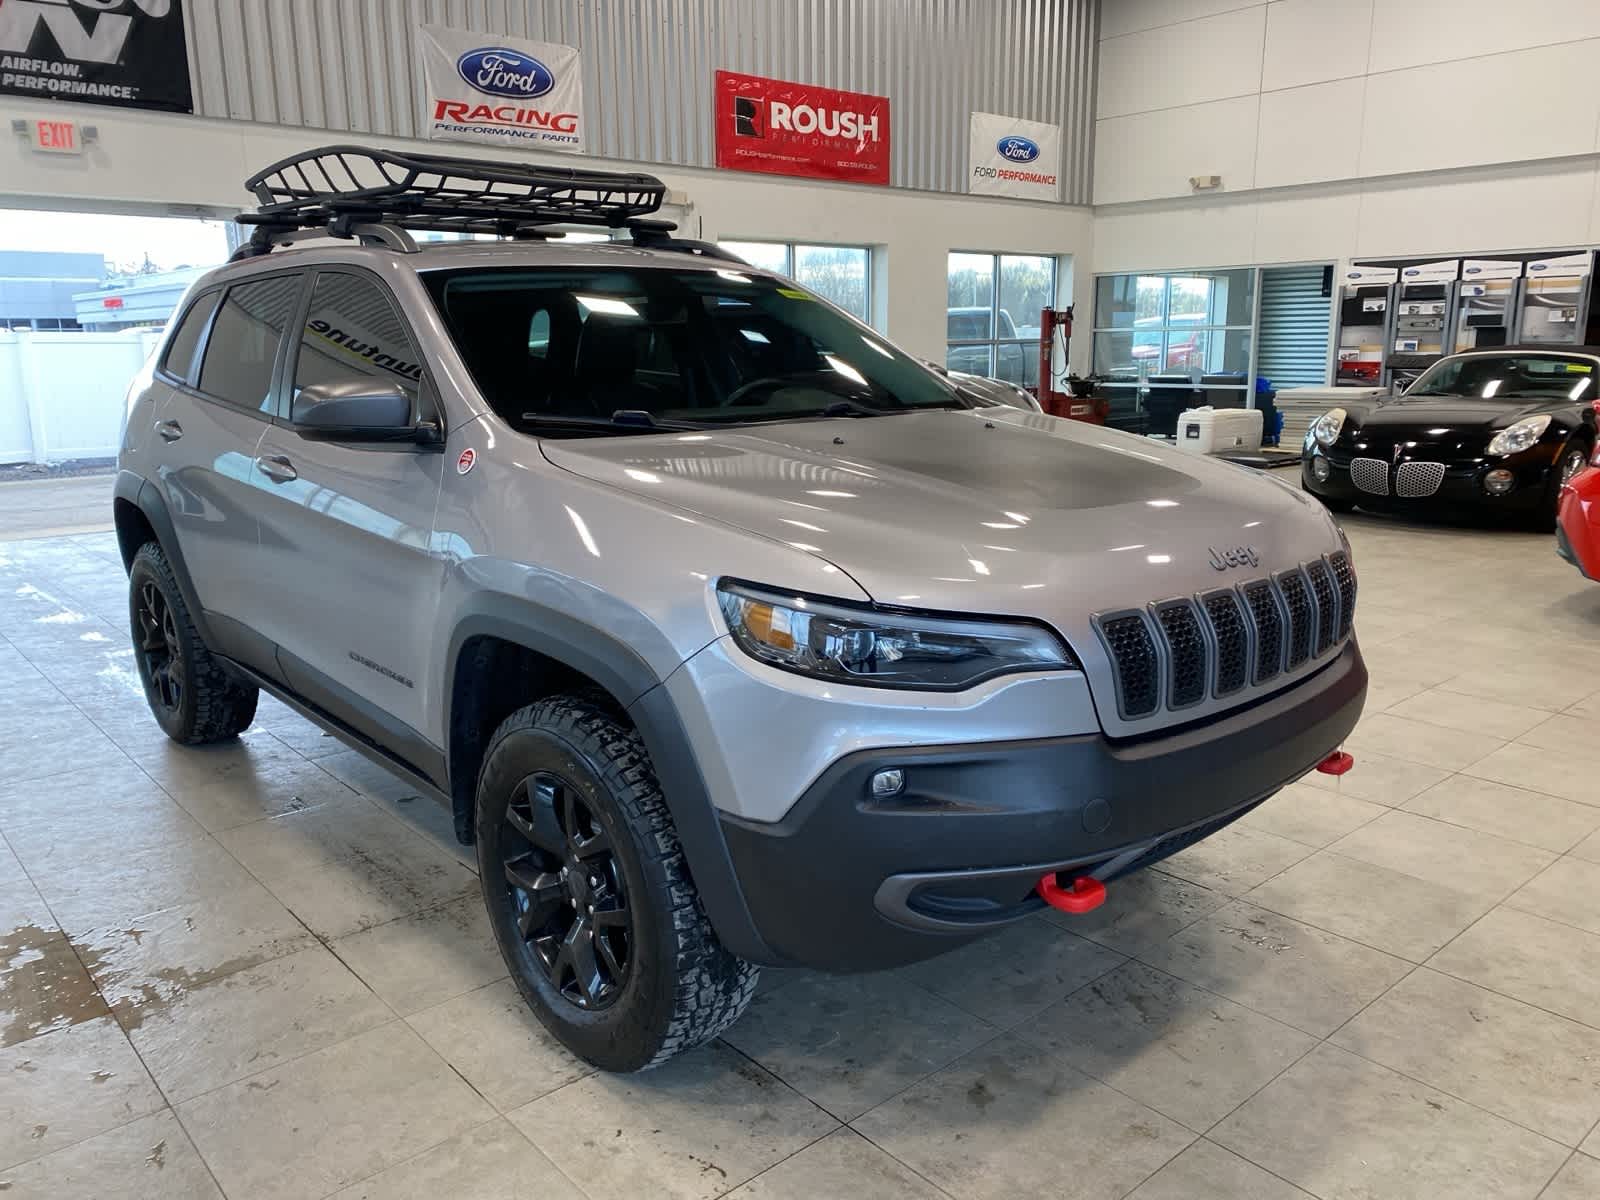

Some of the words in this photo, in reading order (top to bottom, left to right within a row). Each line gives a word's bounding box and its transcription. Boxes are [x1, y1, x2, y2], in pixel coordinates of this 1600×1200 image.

[1, 56, 83, 77] AIRFLOW.
[477, 54, 537, 92] Ford
[434, 99, 579, 133] RACING
[770, 101, 879, 142] ROUSH
[37, 120, 75, 149] EXIT
[435, 123, 538, 139] PERFORMANCE
[541, 133, 579, 143] PARTS
[1005, 140, 1031, 159] Ford
[974, 167, 997, 178] FORD
[997, 169, 1056, 185] PERFORMANCE
[1208, 544, 1258, 571] Jeep
